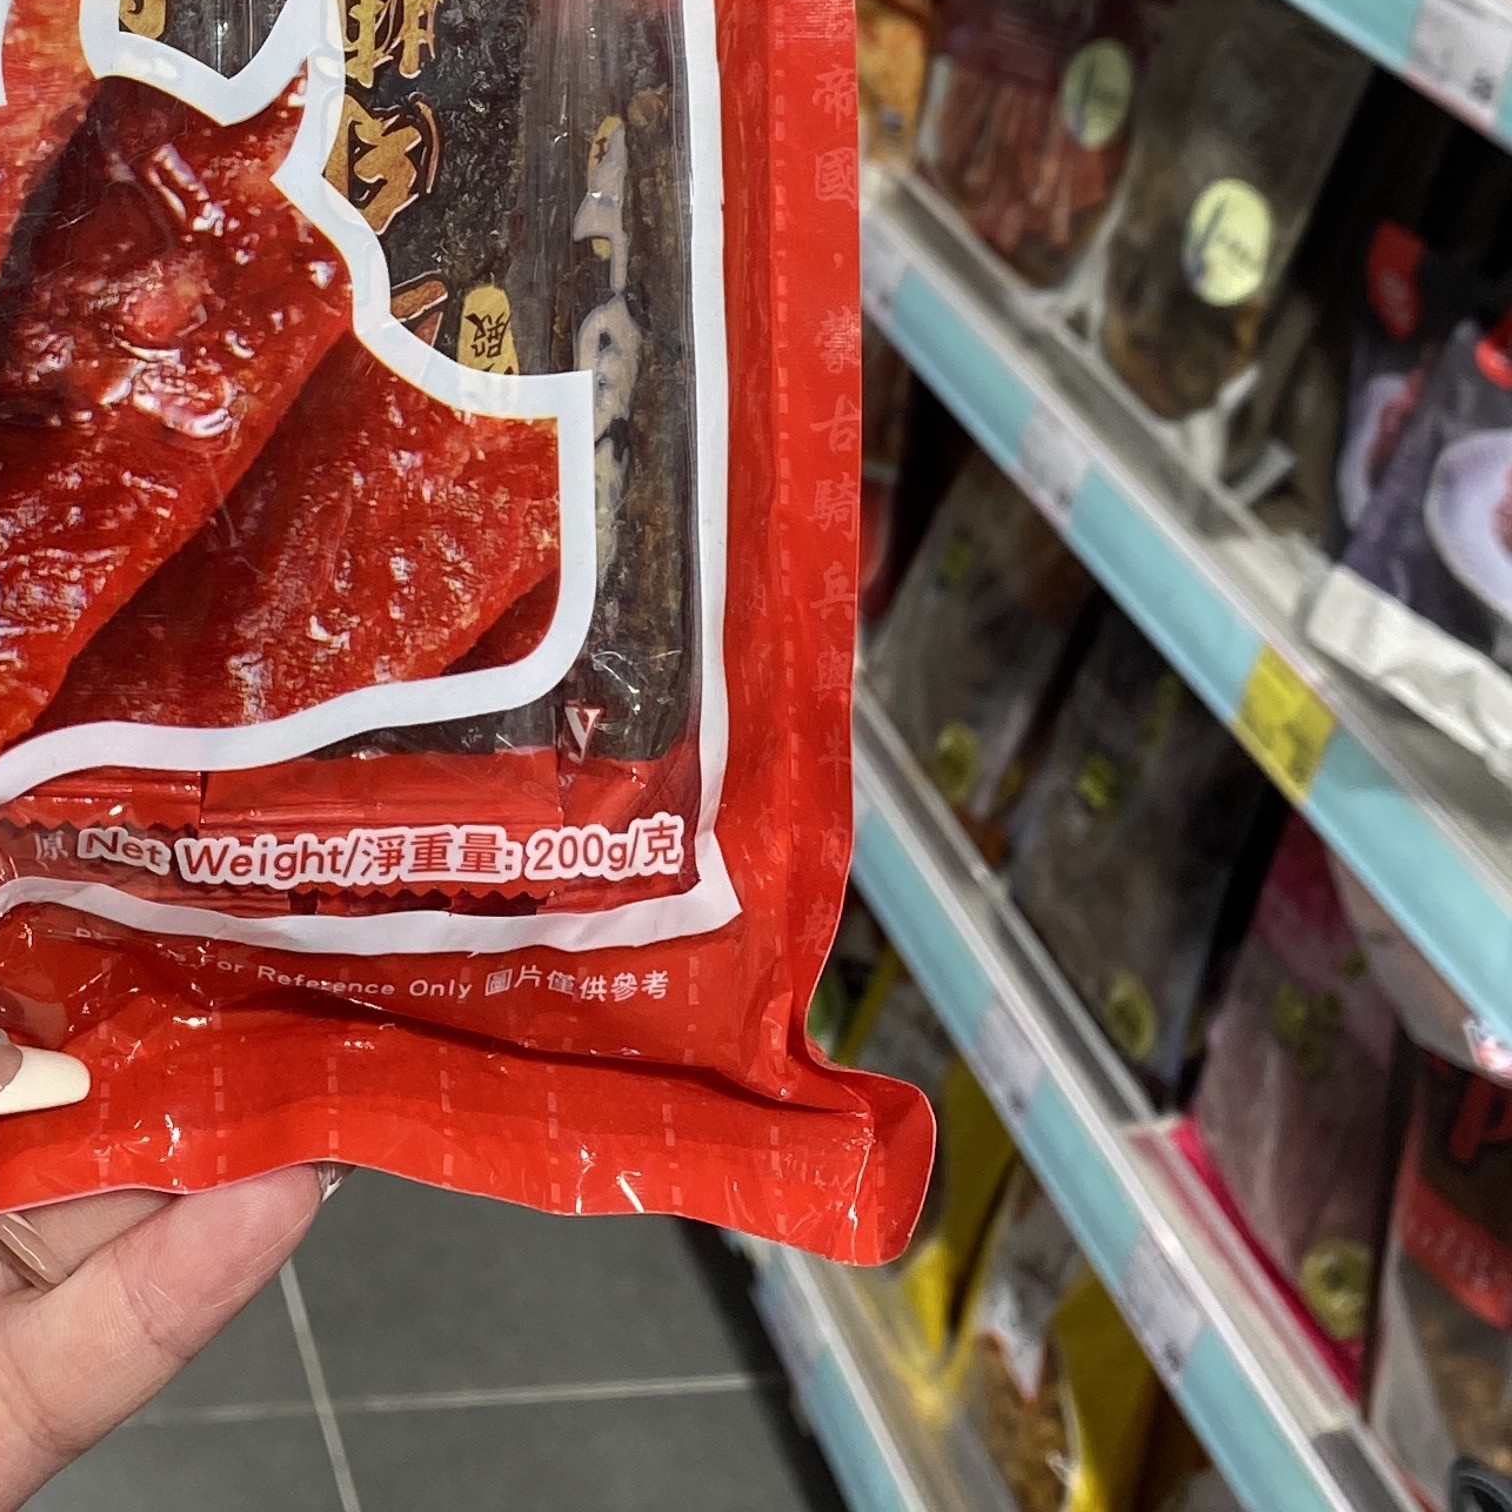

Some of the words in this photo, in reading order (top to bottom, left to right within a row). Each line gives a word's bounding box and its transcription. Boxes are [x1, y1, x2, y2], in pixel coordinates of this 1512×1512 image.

[80, 829, 168, 872] Net
[182, 829, 516, 882] Weight/淨重量:
[530, 817, 681, 875] 200g/克
[257, 964, 395, 996] Reference
[408, 977, 474, 1002] Only
[484, 964, 670, 1003] 圖片僅供參考
